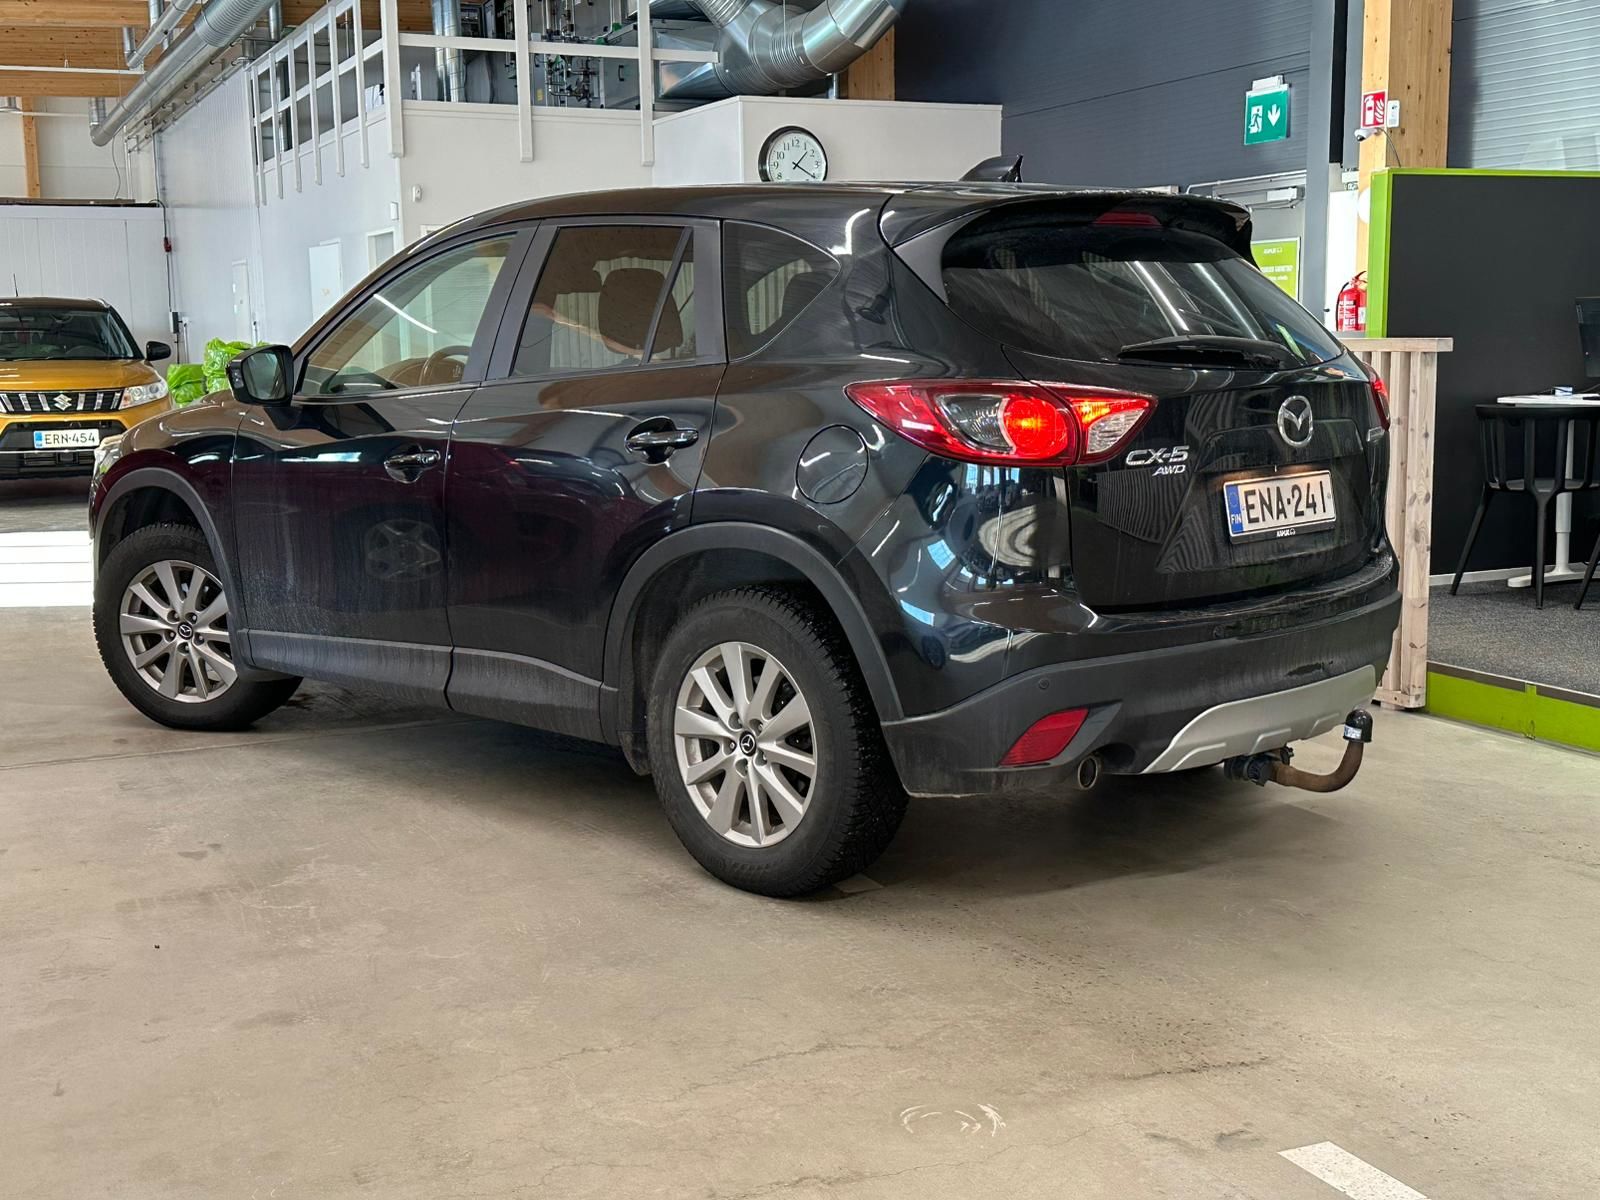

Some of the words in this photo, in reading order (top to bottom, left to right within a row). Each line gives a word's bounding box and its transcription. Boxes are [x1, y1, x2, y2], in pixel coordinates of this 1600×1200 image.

[783, 142, 789, 151] 11
[776, 152, 785, 160] 10
[1125, 445, 1190, 466] CX-5
[1152, 464, 1187, 477] AWD
[1231, 513, 1242, 525] FIN
